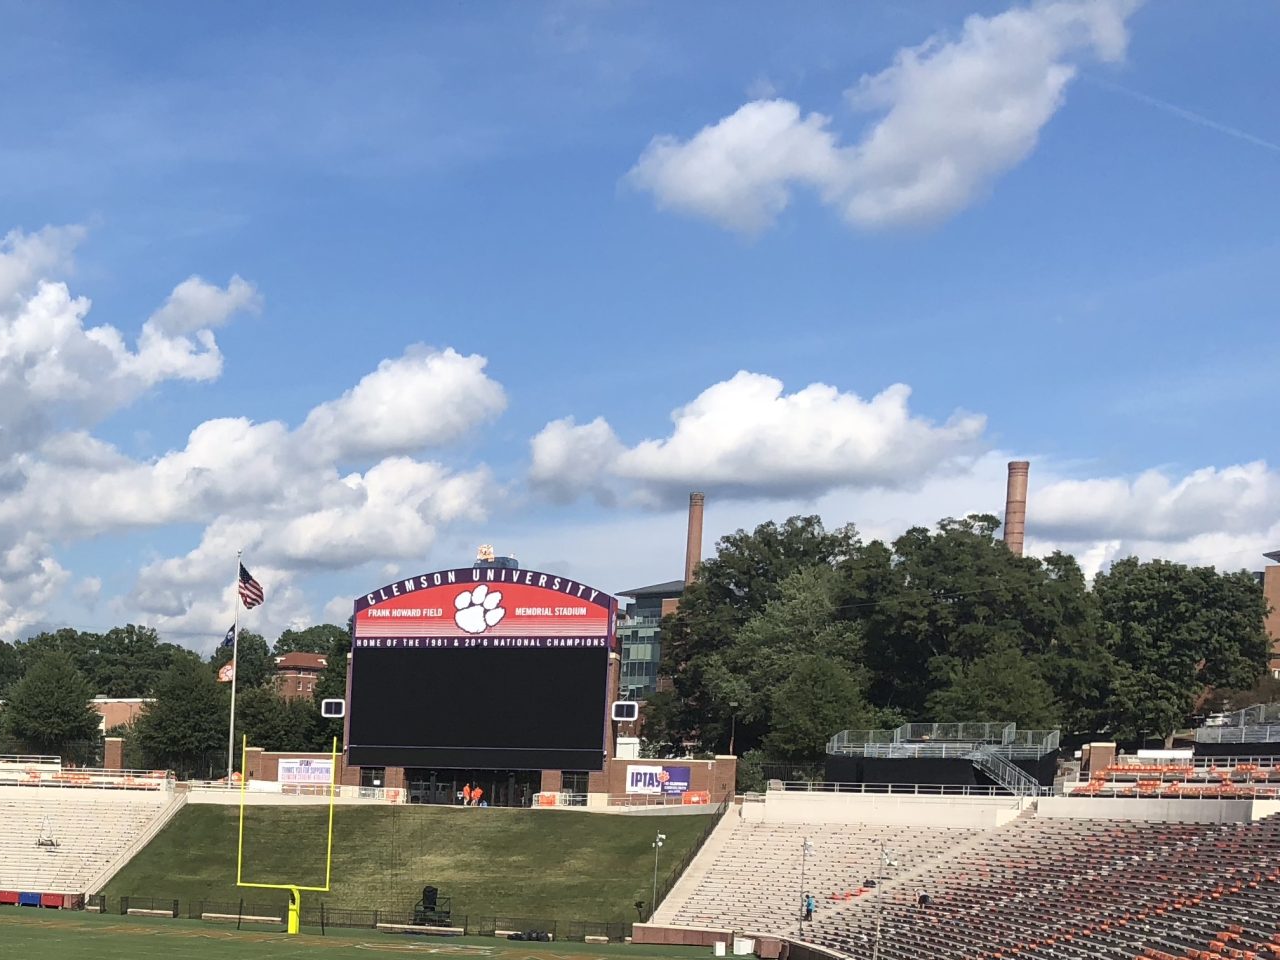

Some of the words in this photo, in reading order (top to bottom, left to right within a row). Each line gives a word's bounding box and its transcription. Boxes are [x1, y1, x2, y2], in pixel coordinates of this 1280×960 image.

[366, 570, 456, 606] CLEMSON
[472, 568, 599, 602] UNIVERSITY
[368, 608, 390, 617] FRANK
[391, 608, 421, 617] HOWARD
[423, 608, 443, 617] FIELD
[515, 607, 552, 616] MEMORIAL
[554, 607, 587, 616] STADIUM
[357, 639, 381, 647] HOME
[386, 639, 398, 647] OF
[403, 639, 419, 647] THE
[425, 639, 448, 647] 1981
[453, 639, 459, 647] &
[493, 639, 541, 647] NATIONAL
[546, 639, 605, 648] CHAMPIONS
